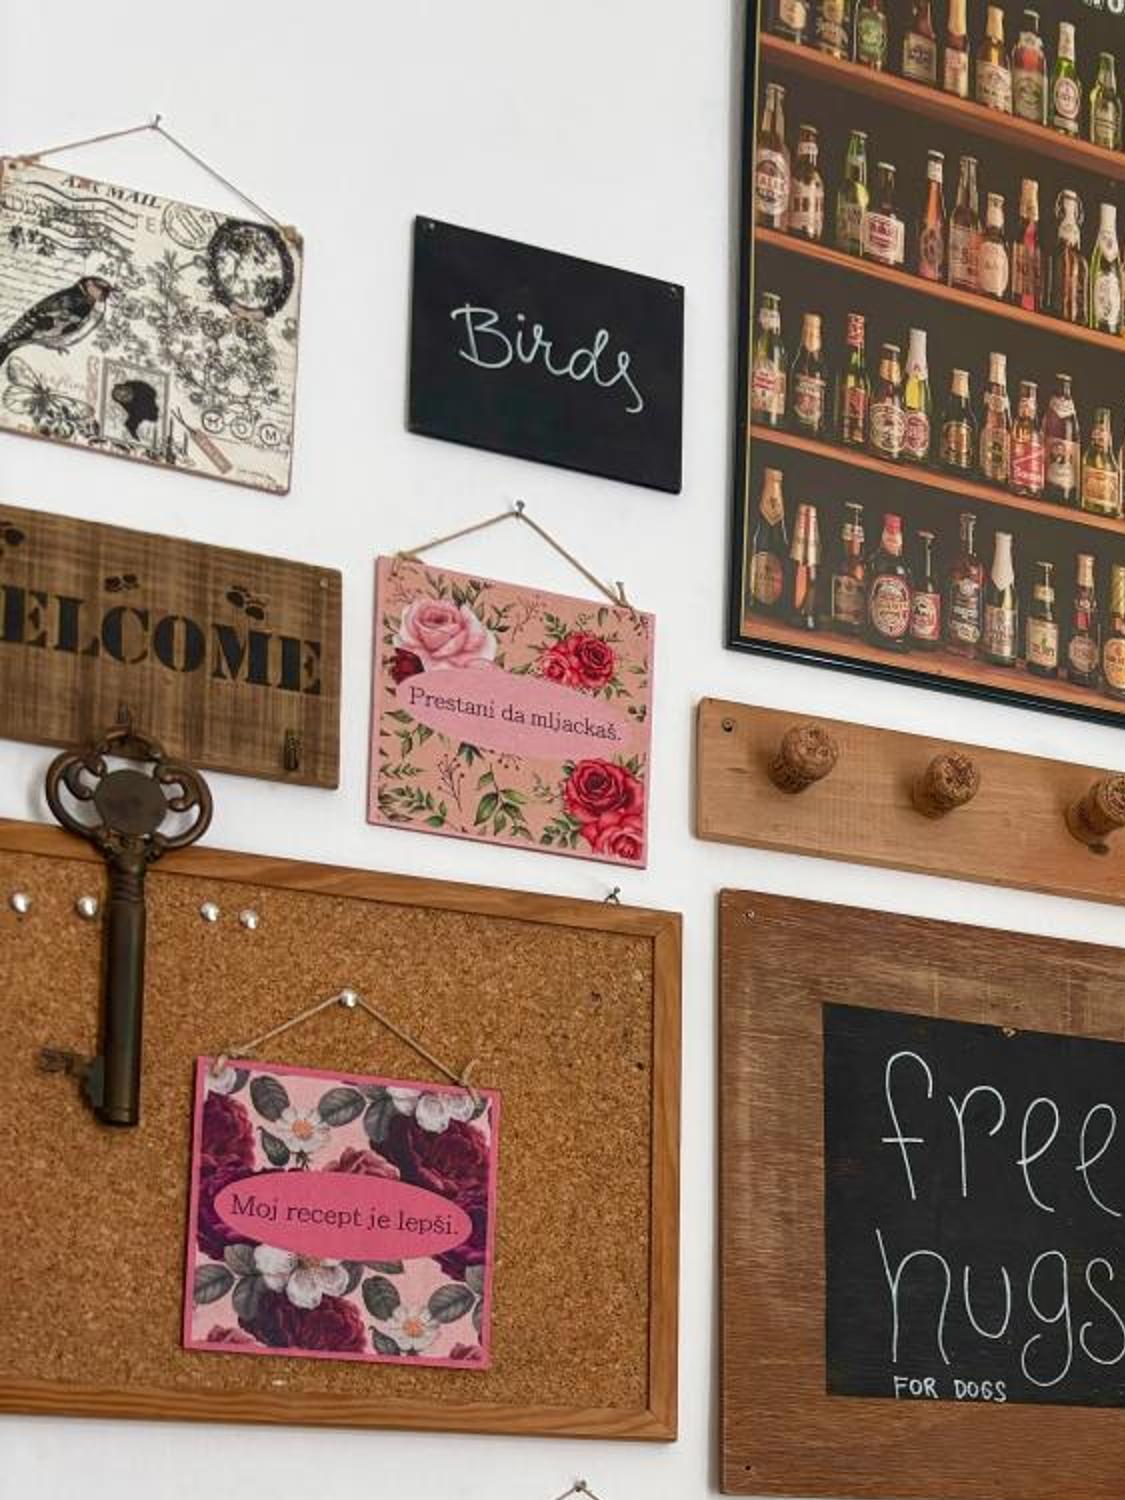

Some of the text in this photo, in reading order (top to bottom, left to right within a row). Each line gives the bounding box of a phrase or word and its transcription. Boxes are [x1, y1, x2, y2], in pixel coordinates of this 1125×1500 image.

[106, 187, 162, 209] MAIL
[450, 302, 644, 414] Birds
[408, 685, 623, 742] Prestani da mljackaš.
[881, 1050, 1123, 1217] free
[230, 1193, 459, 1236] Moj recept je lepši.
[893, 1375, 1008, 1403] FOR DOGS
